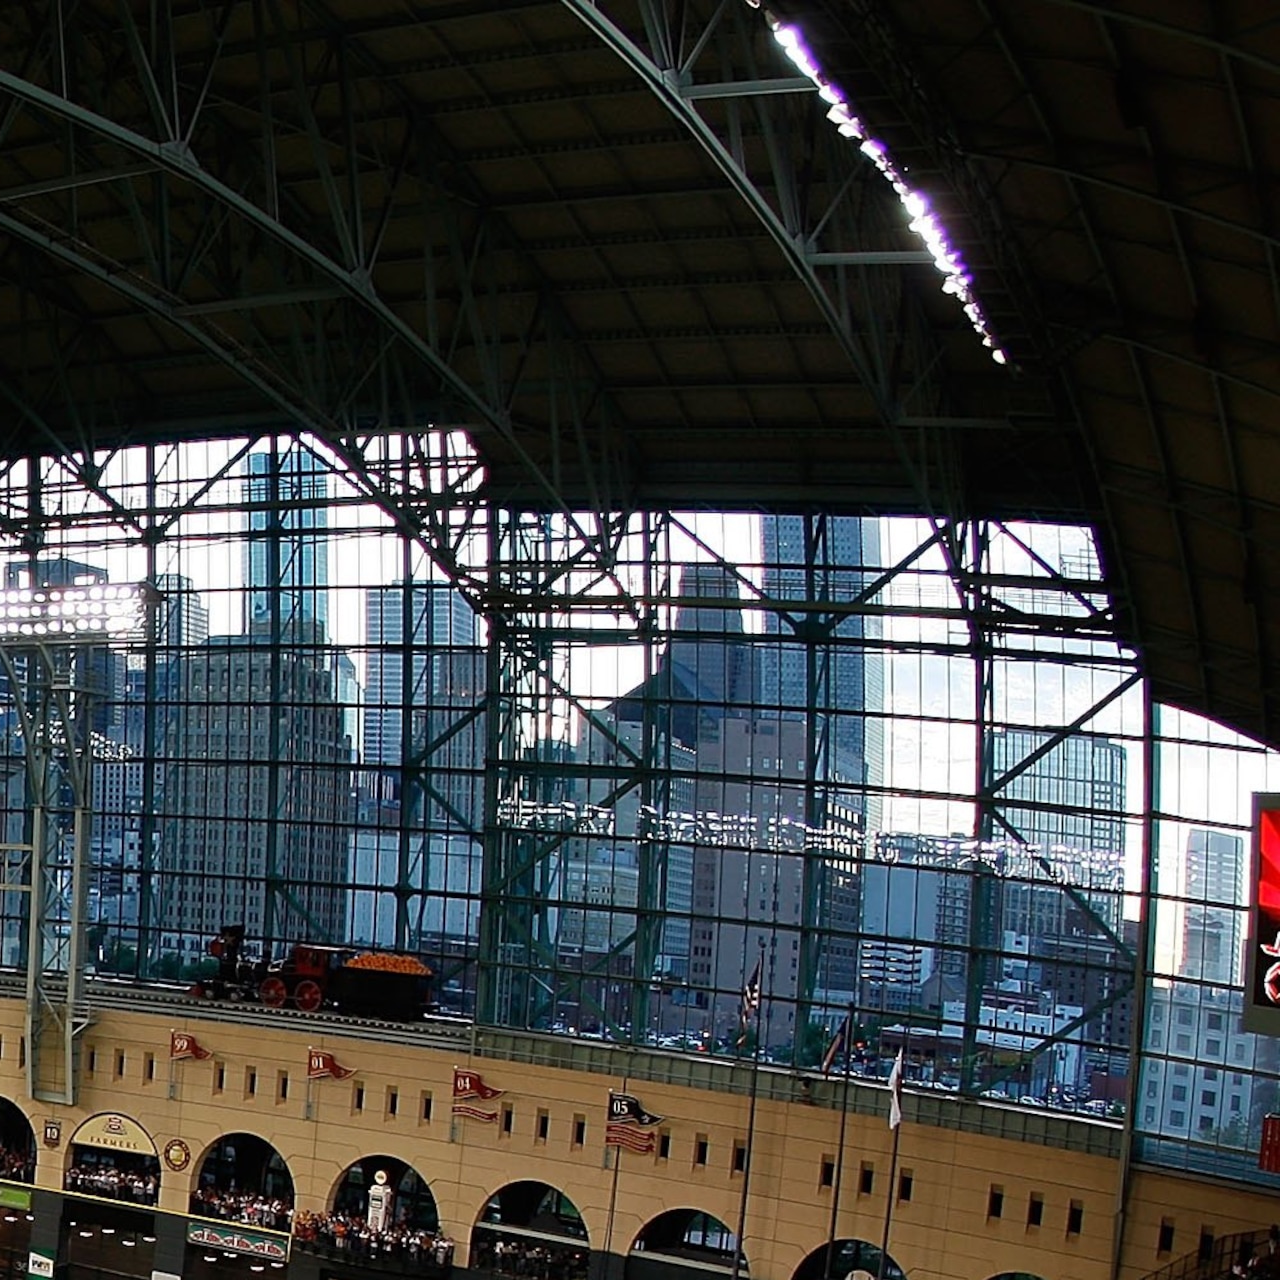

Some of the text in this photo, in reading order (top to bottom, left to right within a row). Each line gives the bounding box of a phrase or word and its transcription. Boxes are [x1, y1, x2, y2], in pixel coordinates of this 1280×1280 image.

[174, 1039, 188, 1051] 99
[311, 1057, 324, 1069] 01
[457, 1078, 471, 1090] 04
[613, 1101, 629, 1114] 05
[46, 1128, 58, 1139] 10
[90, 1136, 138, 1150] FARMERS
